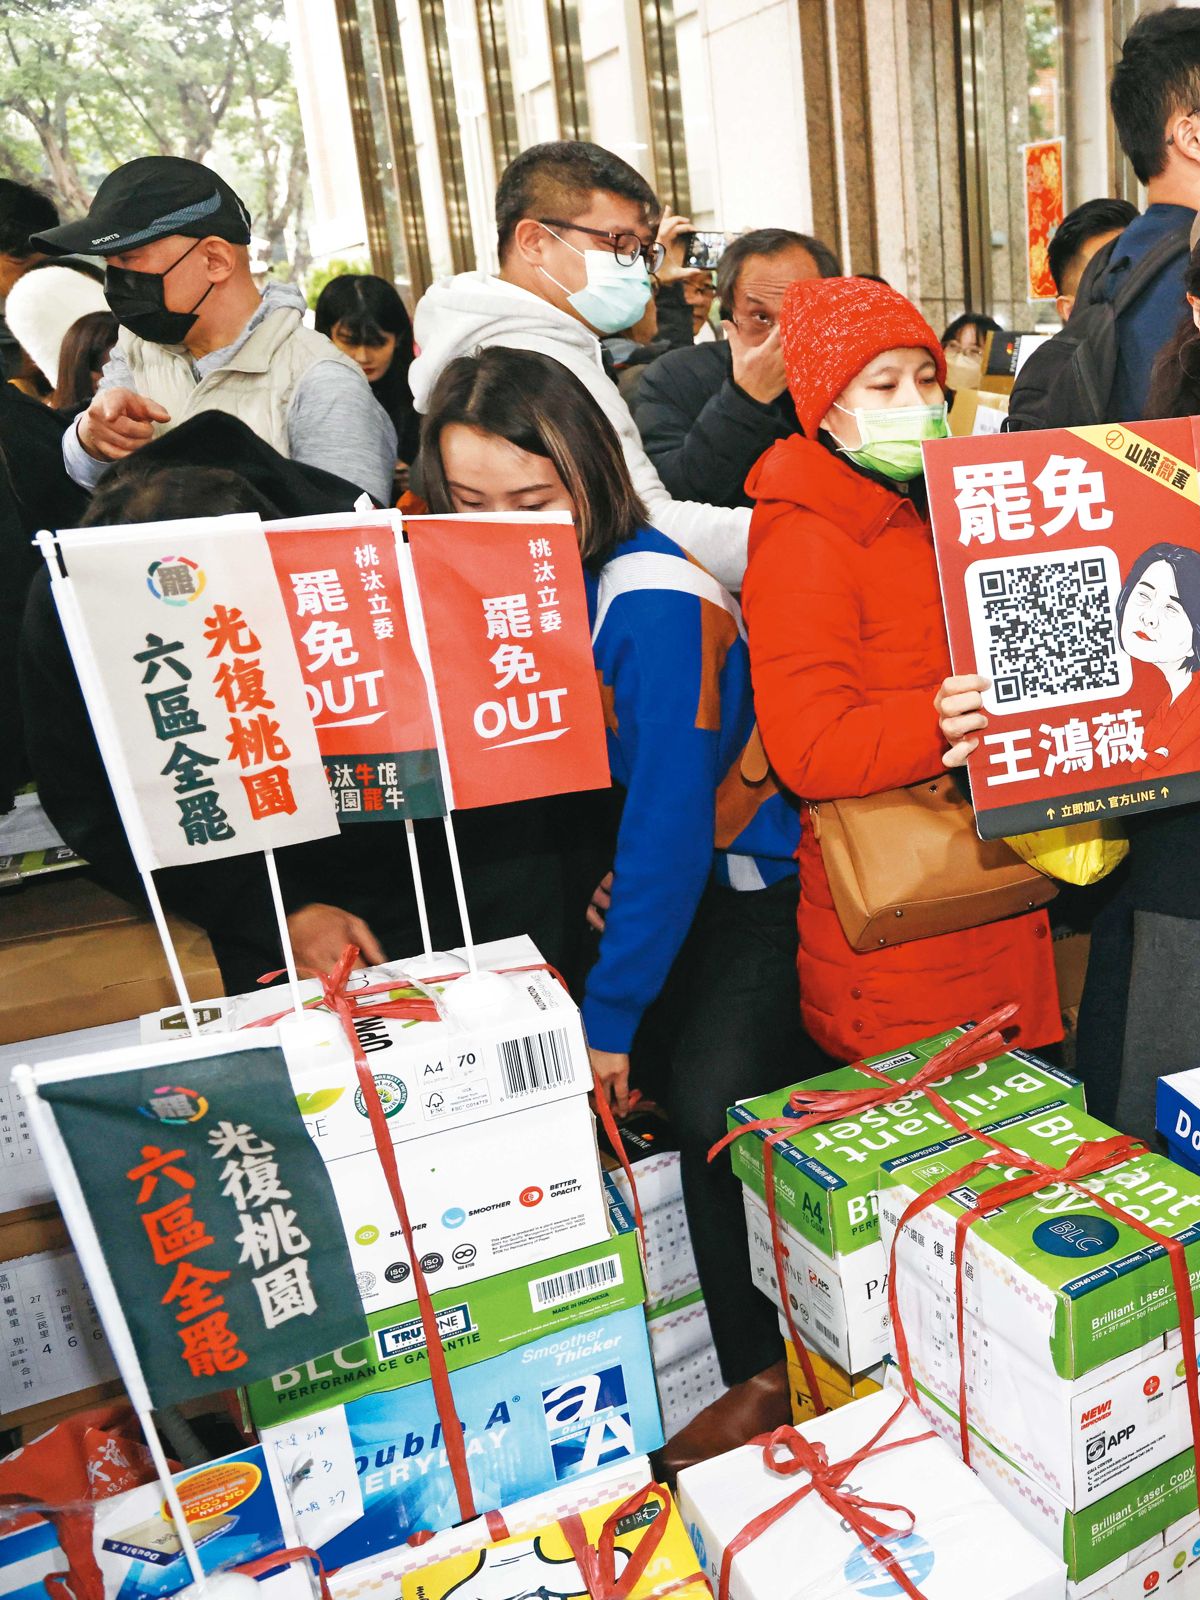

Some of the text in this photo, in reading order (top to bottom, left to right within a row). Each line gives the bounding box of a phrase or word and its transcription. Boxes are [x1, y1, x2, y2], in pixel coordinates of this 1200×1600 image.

[91, 233, 120, 245] SPORTS
[1124, 441, 1190, 491] 山除薇害
[952, 454, 1114, 547] 罷免
[353, 544, 395, 640] 桃汰立委
[528, 538, 562, 633] 桃汰立委
[290, 568, 360, 673] 罷免
[482, 593, 541, 690] 罷免
[204, 604, 298, 821] 光復桃園
[473, 688, 568, 740] OUT
[132, 633, 236, 846] 六區全罷
[984, 709, 1149, 786] 王鴻薇
[1061, 787, 1156, 819] 立即加入 官方LINE
[423, 1052, 477, 1077] A4 70
[549, 1178, 578, 1191] BETTER
[550, 1185, 583, 1199] OPACITY
[468, 1200, 512, 1217] SMOOTHER
[802, 1191, 823, 1223] A4
[208, 1121, 319, 1330] 光復桃園
[882, 1208, 925, 1248] 桃園六選區
[1049, 1220, 1104, 1252] BLC
[126, 1145, 250, 1377] 六區全罷
[389, 1267, 406, 1277] ISO
[423, 1257, 439, 1267] ISO
[30, 1294, 41, 1304] 27
[55, 1287, 68, 1297] 28
[552, 1304, 570, 1315] MADE
[577, 1292, 611, 1307] INDONESIA
[1091, 1283, 1170, 1331] Brilliant Laser
[35, 1312, 49, 1338] 三民里
[92, 1330, 103, 1342] 6
[42, 1342, 53, 1355] 4
[68, 1336, 78, 1349] 6
[521, 1327, 605, 1364] Smoother
[555, 1335, 622, 1366] Thicker
[277, 1332, 481, 1404] PERFORMANCE GANTIE
[485, 1401, 511, 1430] A
[1081, 1400, 1112, 1424] NEW!
[1107, 1424, 1136, 1450] APP
[224, 1489, 245, 1501] QR
[1091, 1503, 1132, 1535] Brilliant
[1136, 1483, 1166, 1507] Laser
[1169, 1464, 1197, 1486] Copy
[1147, 1498, 1165, 1514] Sheets
[121, 1543, 160, 1561] Double
